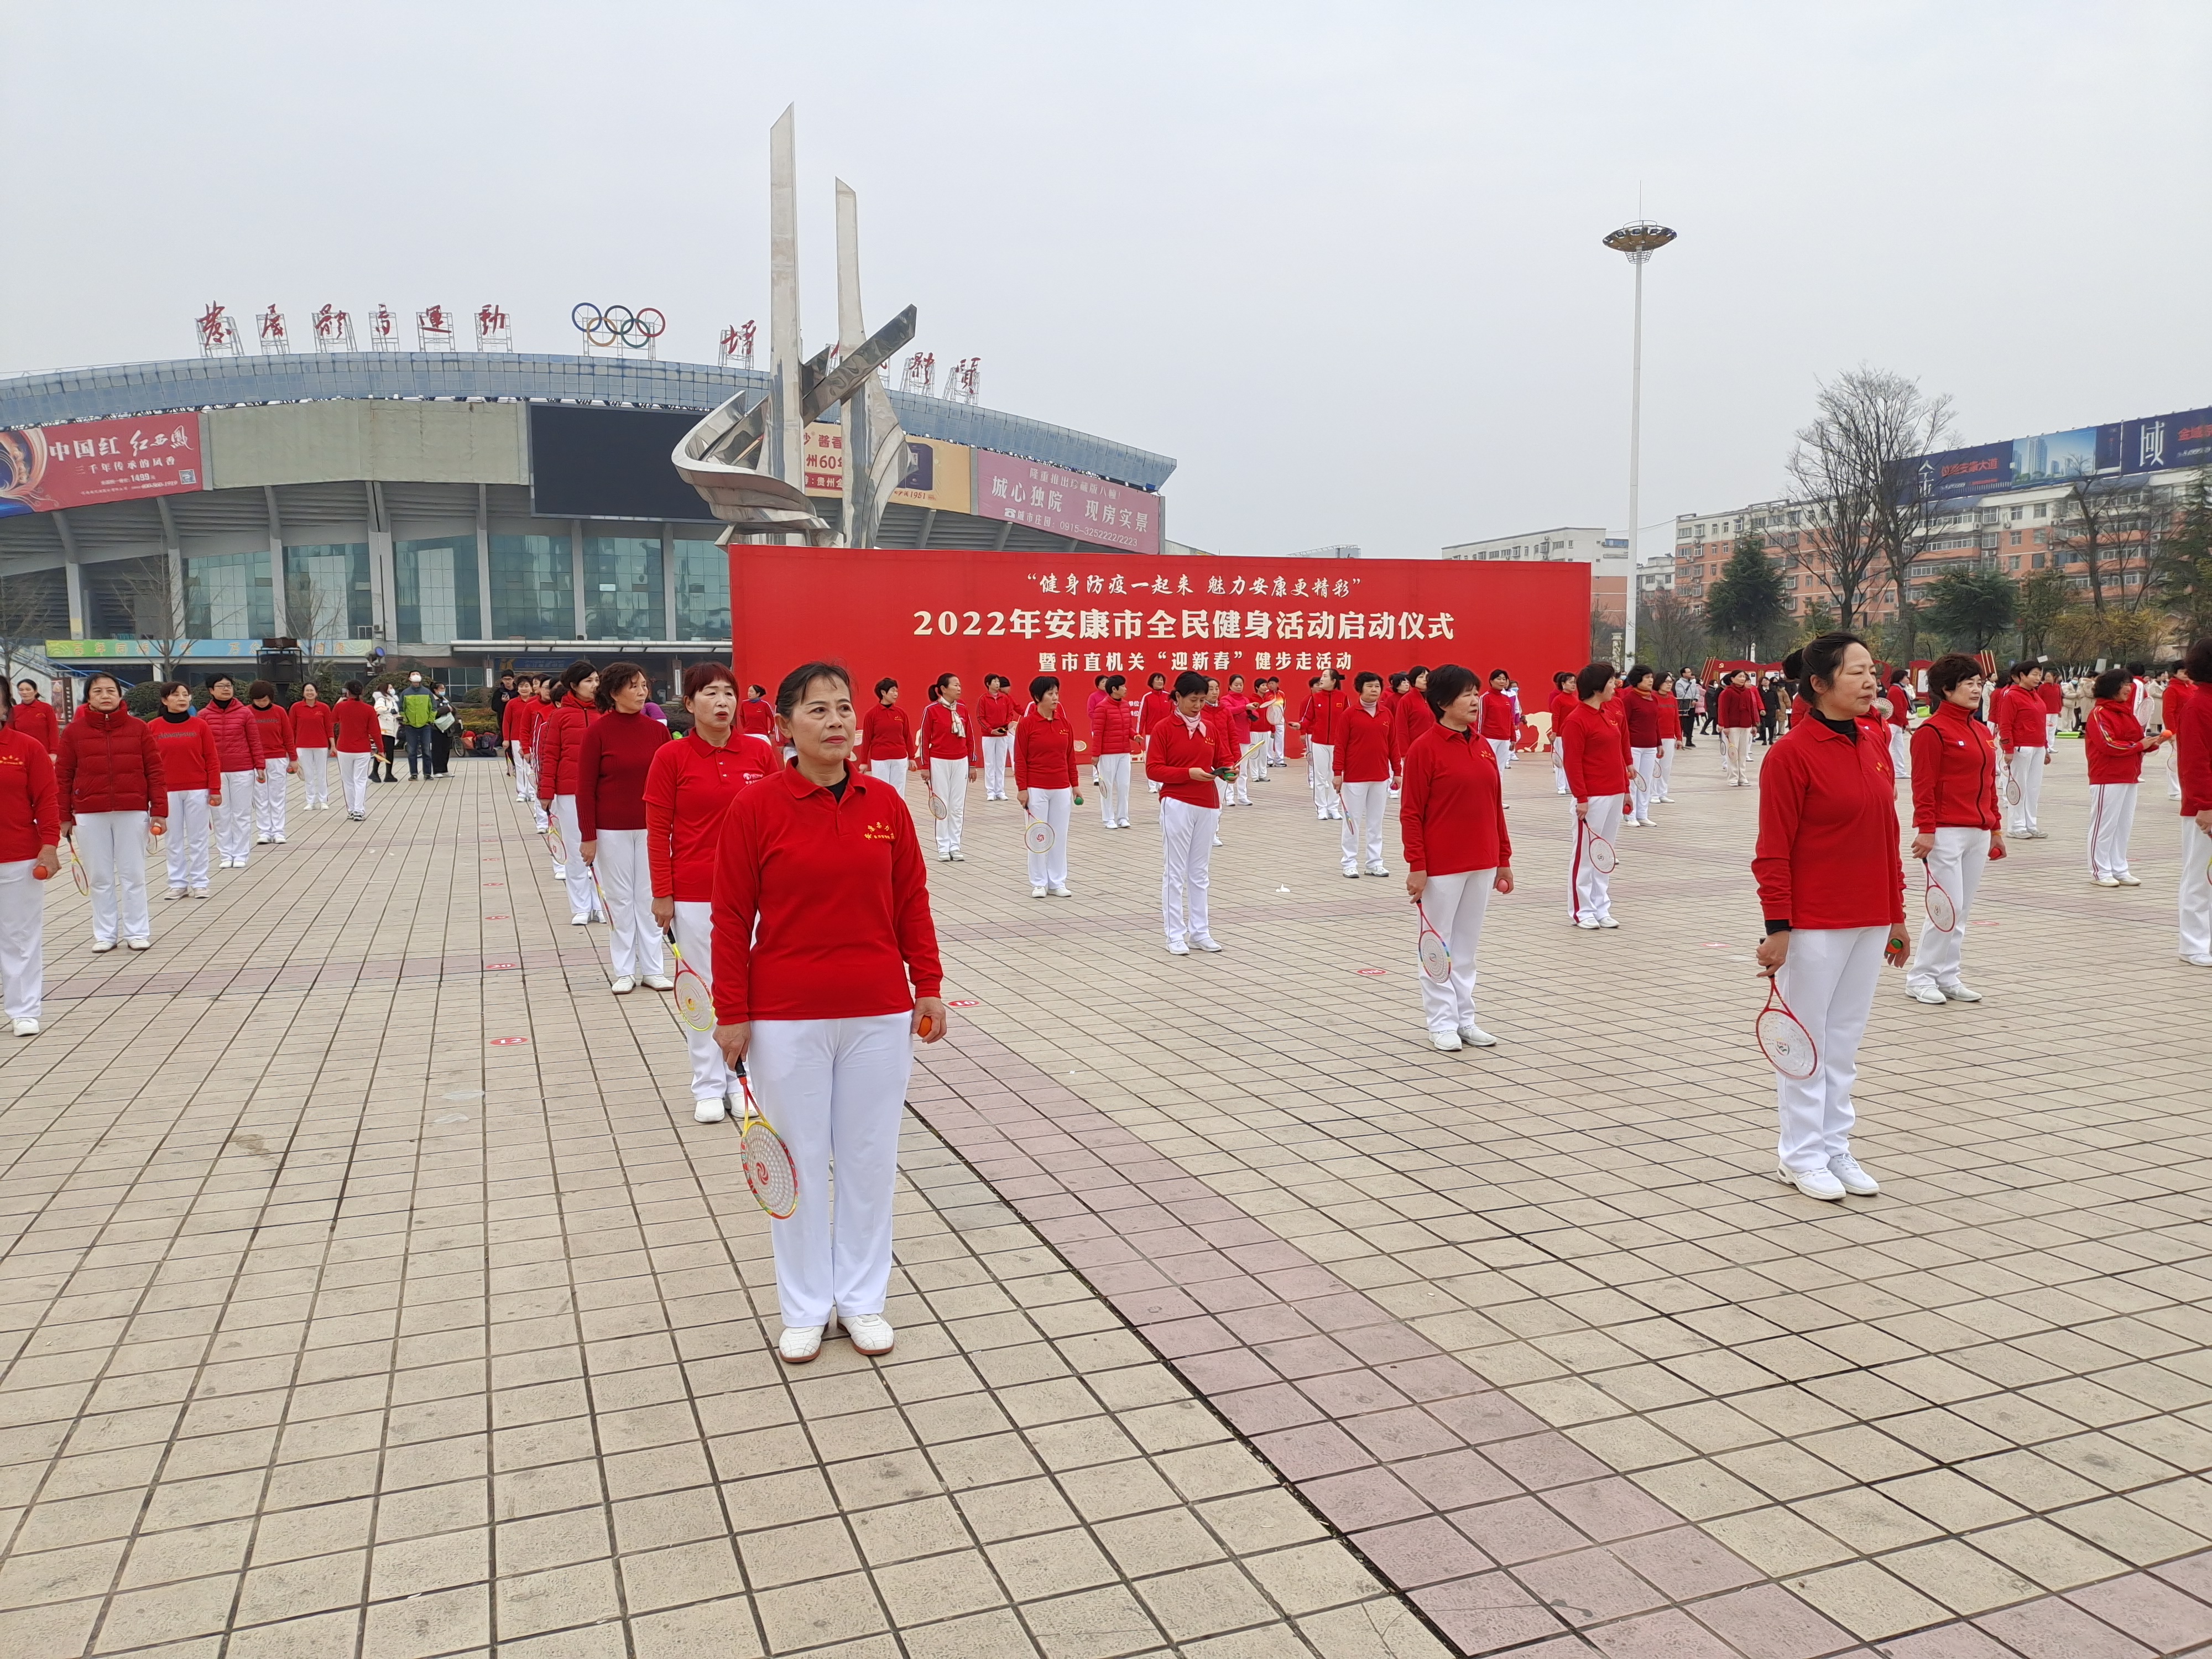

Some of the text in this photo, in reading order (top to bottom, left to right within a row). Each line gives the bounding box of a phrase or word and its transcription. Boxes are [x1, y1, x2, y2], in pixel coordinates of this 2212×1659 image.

[49, 436, 121, 461] 中国红
[1084, 499, 1148, 533] 现房实景
[913, 608, 1454, 640] 2022年安康市全民健身活动启动仪式
